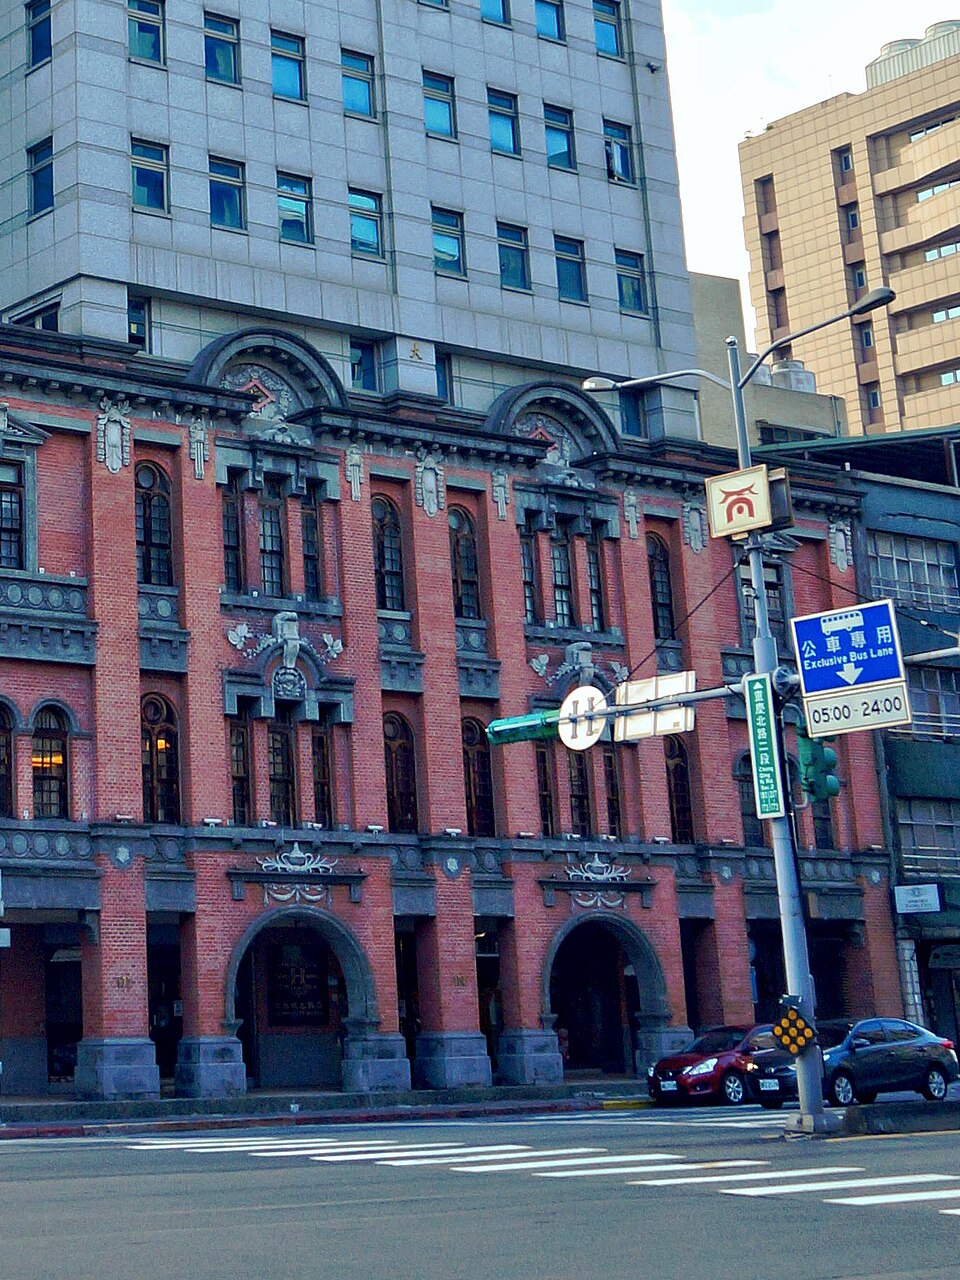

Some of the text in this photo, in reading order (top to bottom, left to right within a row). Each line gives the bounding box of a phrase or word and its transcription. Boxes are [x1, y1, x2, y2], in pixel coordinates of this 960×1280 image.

[801, 625, 892, 658] 公車專用
[803, 647, 894, 670] Exclusive Bus Lane
[812, 704, 851, 724] 05:00
[861, 696, 902, 718] 24:00
